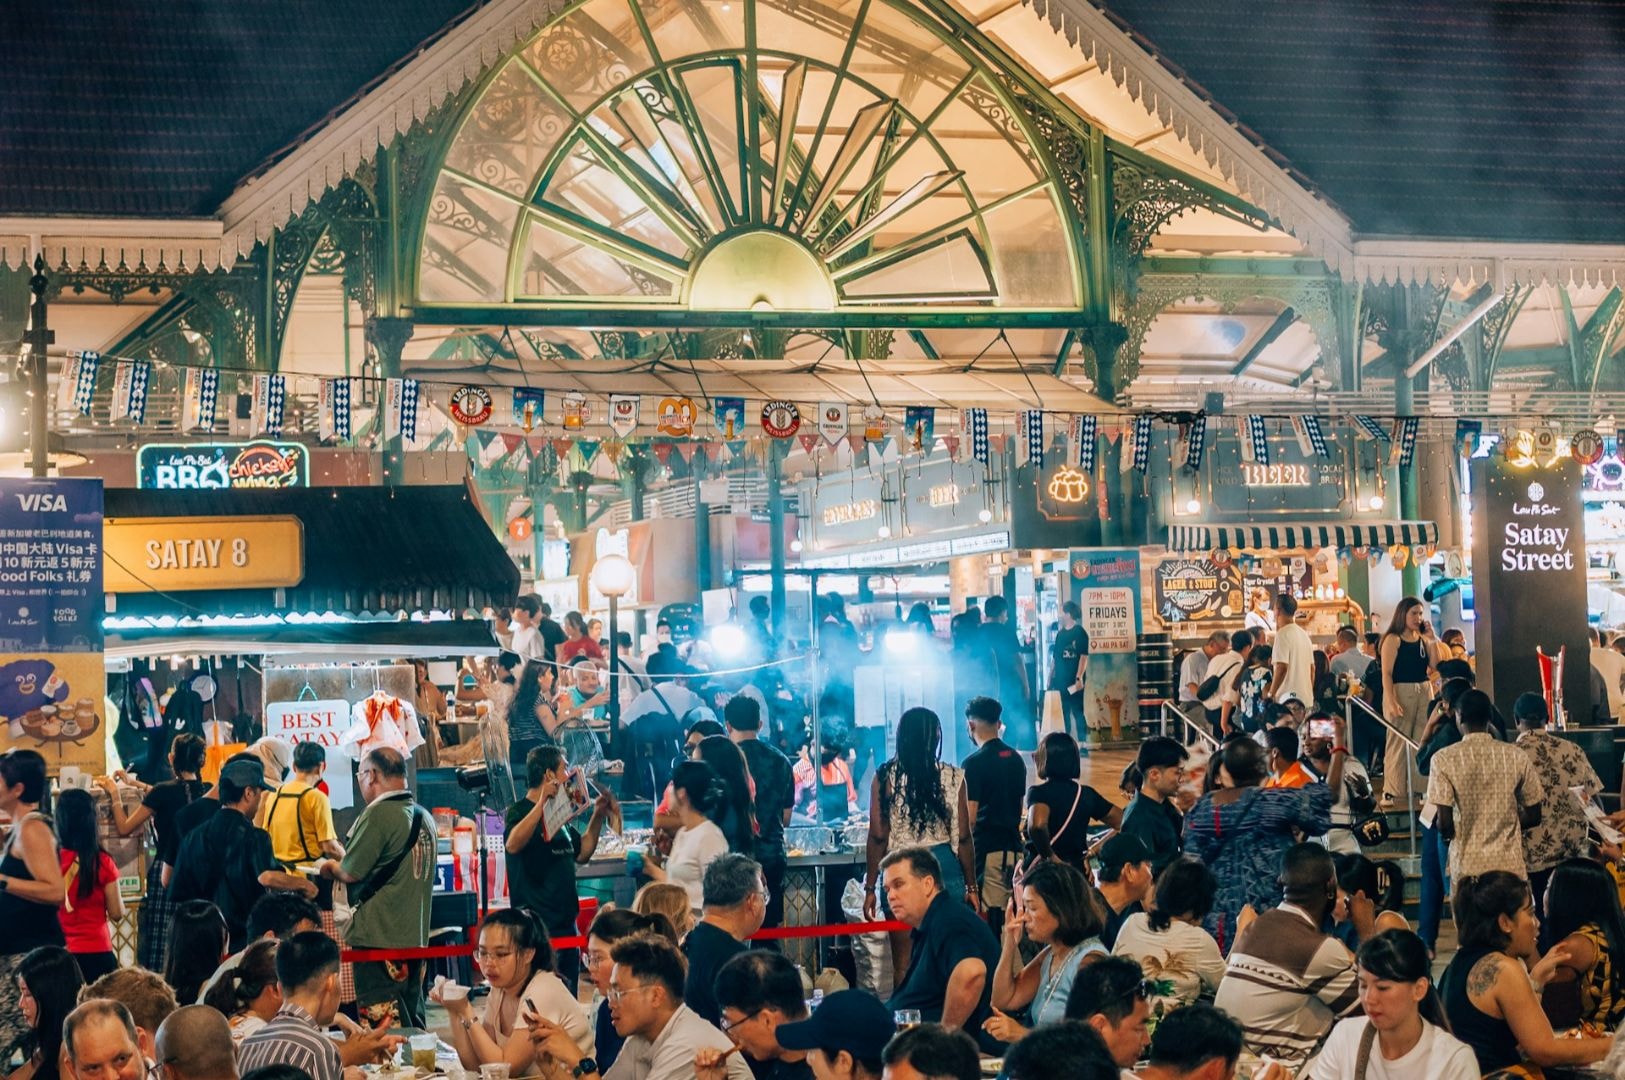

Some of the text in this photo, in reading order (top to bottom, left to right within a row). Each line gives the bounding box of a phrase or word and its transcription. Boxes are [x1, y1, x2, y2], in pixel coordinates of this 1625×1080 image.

[453, 386, 491, 405] ERDINGER
[763, 400, 798, 418] ERDINGER
[1573, 430, 1601, 446] ERDINGER
[1245, 464, 1310, 485] BEER
[15, 494, 67, 512] VISA
[1513, 502, 1531, 514] Lau
[1541, 504, 1561, 515] Sat
[1505, 522, 1569, 551] Satay
[56, 543, 83, 555] Visa
[85, 542, 97, 556] 卡
[145, 538, 247, 570] SATAY 8
[61, 557, 69, 568] 5
[1502, 548, 1574, 571] Street
[0, 570, 27, 582] ood
[30, 570, 64, 582] Folks
[1163, 580, 1186, 590] LAGER
[1195, 579, 1217, 589] STOUT
[1088, 592, 1103, 600] 7PM
[1110, 591, 1126, 600] 10PM
[1089, 607, 1127, 619] FRIDAYS
[1099, 641, 1110, 649] LAU
[1119, 640, 1129, 648] SAT
[281, 711, 336, 729] BEST
